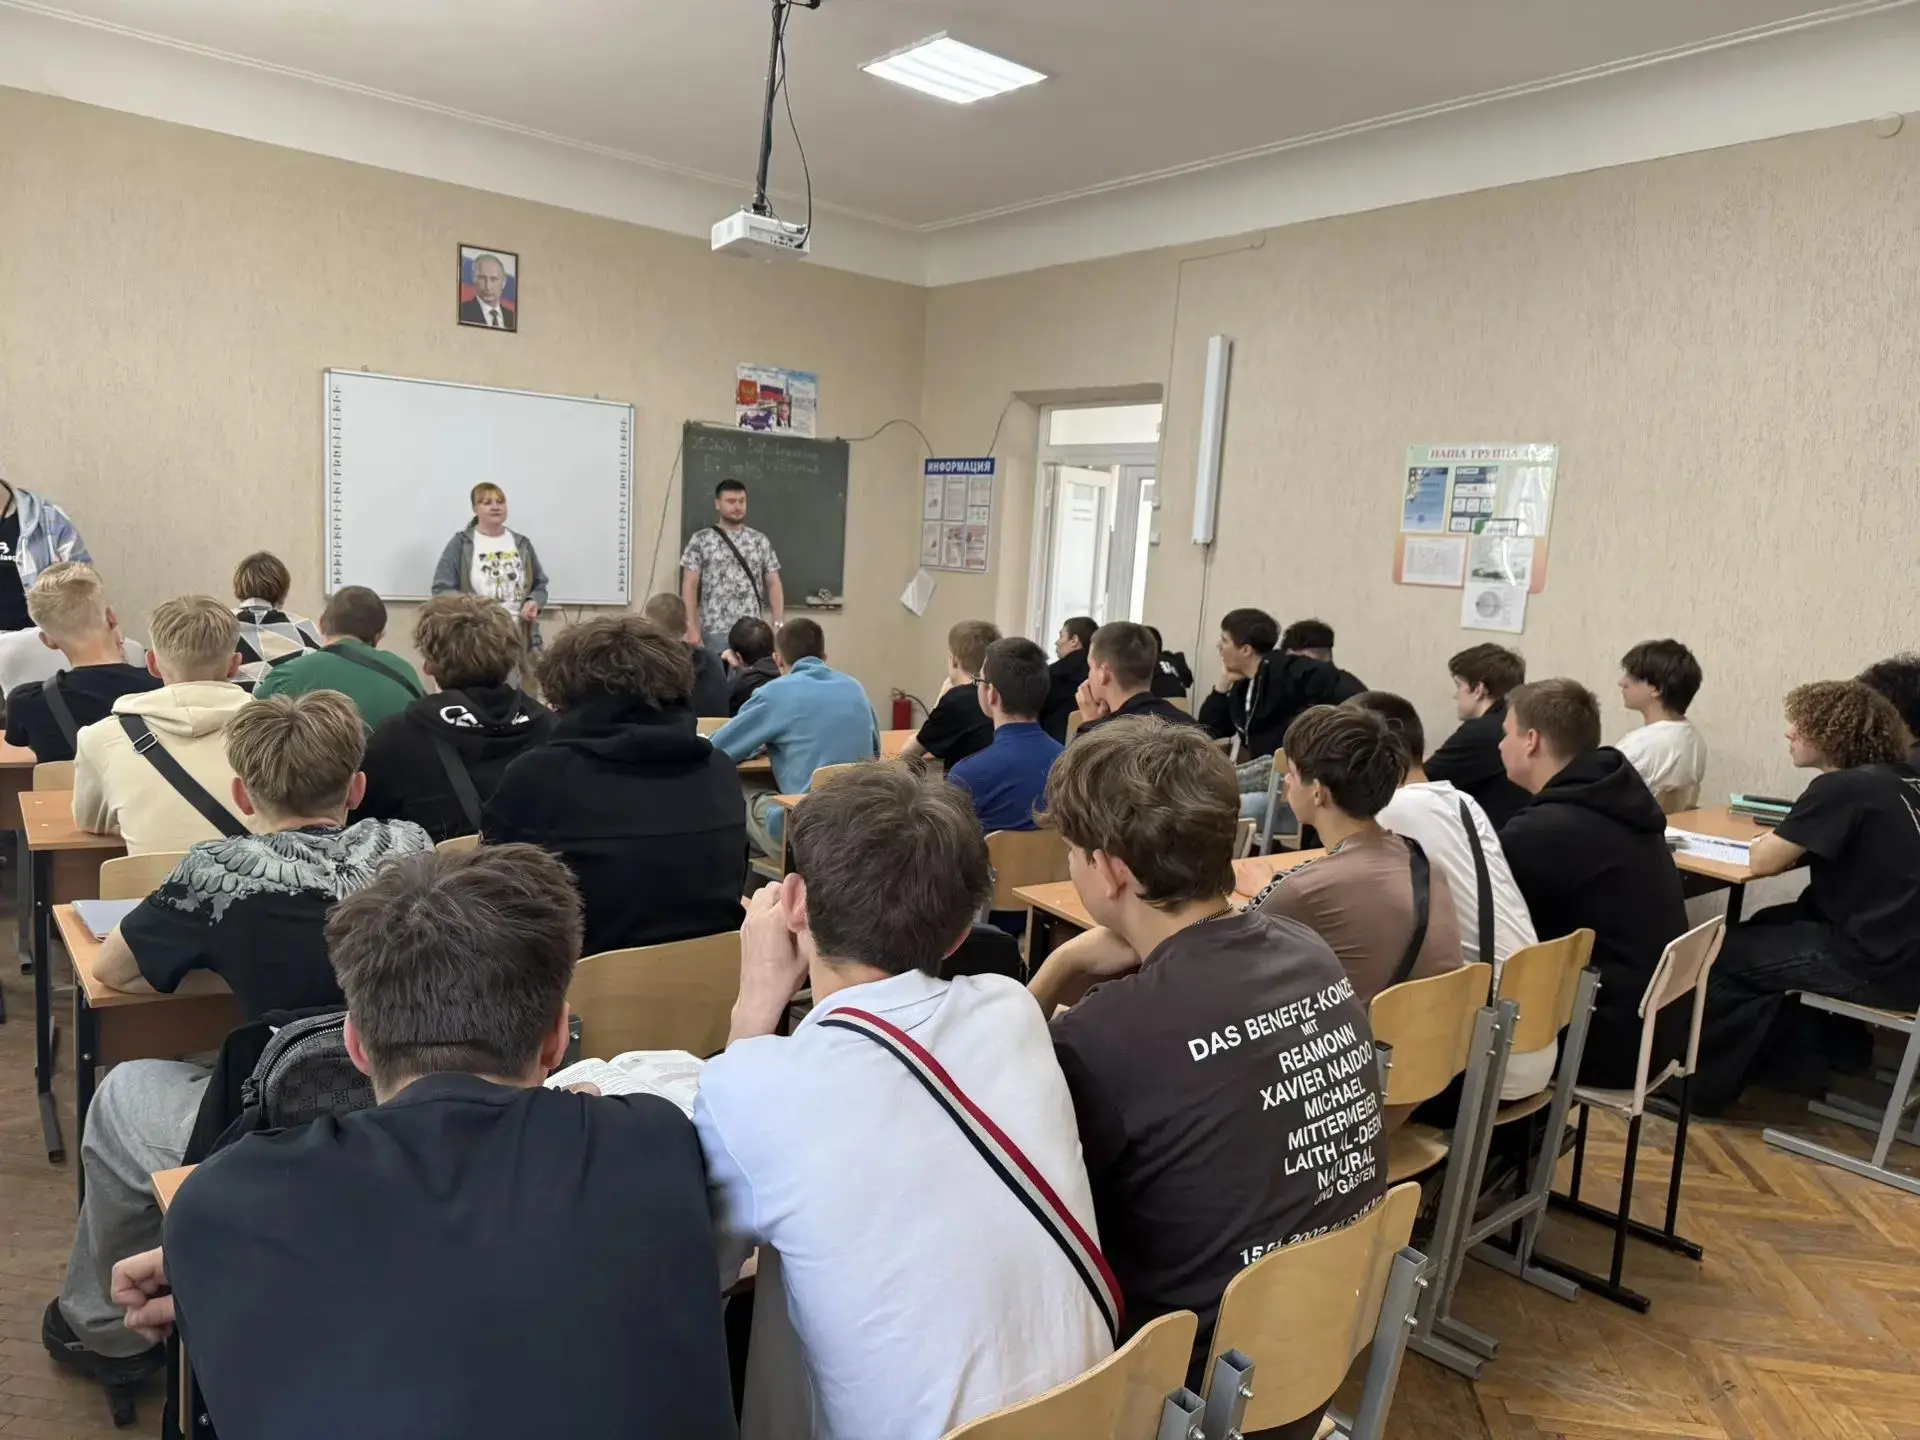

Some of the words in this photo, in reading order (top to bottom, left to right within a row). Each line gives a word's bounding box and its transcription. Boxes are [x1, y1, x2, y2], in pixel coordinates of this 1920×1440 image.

[927, 461, 991, 473] ИНФОРМАЦИЯ
[1430, 448, 1466, 459] НАША
[1471, 448, 1518, 459] ГРУППА
[1188, 1025, 1242, 1062] DAS
[1278, 1022, 1357, 1074] REAMONN
[1300, 1019, 1319, 1036] MIT
[1260, 1067, 1327, 1110] XAVIER
[1328, 1040, 1372, 1083] NAIDOO
[1304, 1076, 1366, 1120] MICHAEL
[1287, 1092, 1378, 1150] MITTERMEIER
[1284, 1141, 1338, 1176] LAITH
[1339, 1112, 1383, 1152] AL-DEEN
[1317, 1145, 1375, 1190] NATURAL
[1336, 1164, 1376, 1194] GÄSTEN
